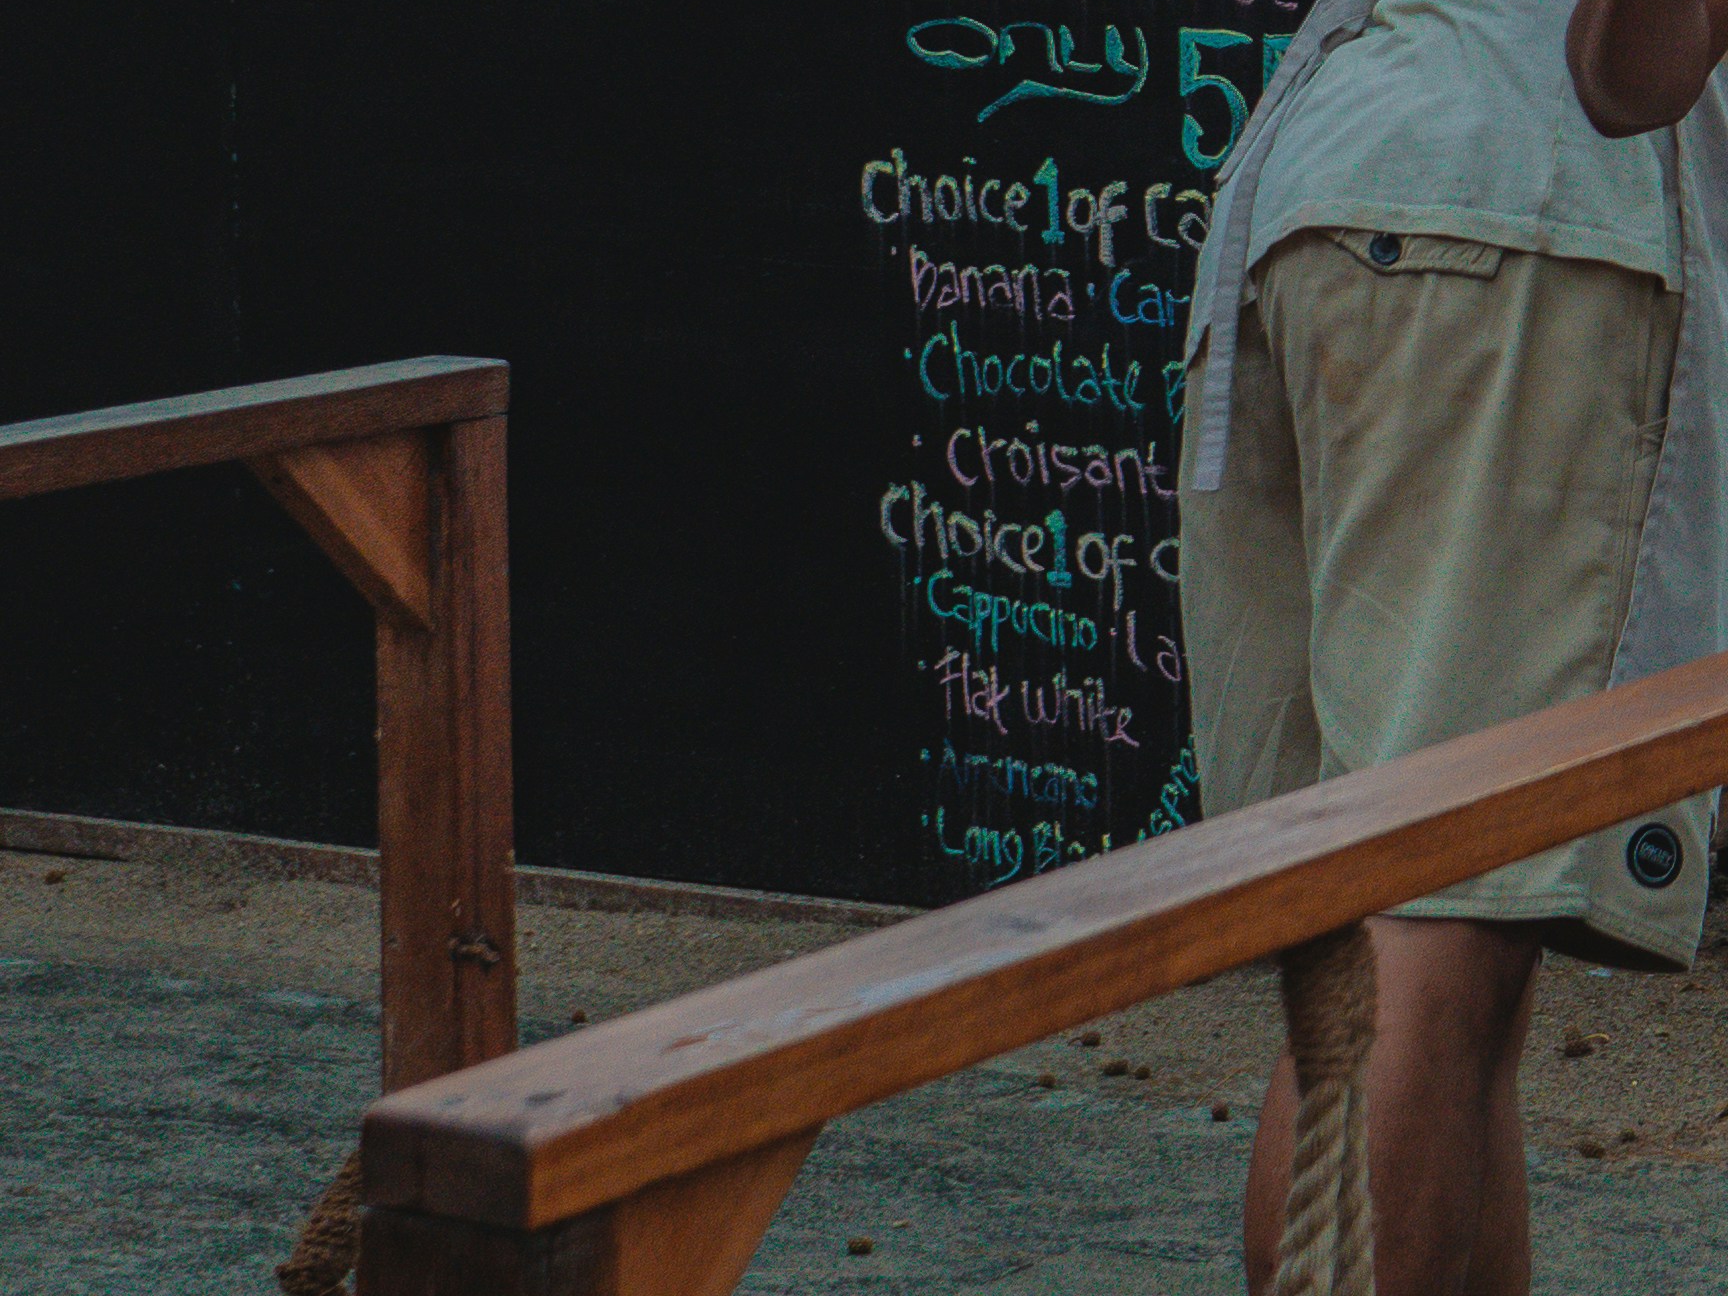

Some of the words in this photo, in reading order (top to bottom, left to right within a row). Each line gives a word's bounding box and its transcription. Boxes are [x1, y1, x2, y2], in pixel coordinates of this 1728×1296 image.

[1067, 181, 1128, 267] of
[909, 245, 1076, 321] Banana
[919, 319, 1143, 409] Chocolate
[947, 419, 1180, 498] Croisant
[936, 806, 1025, 890] Long
